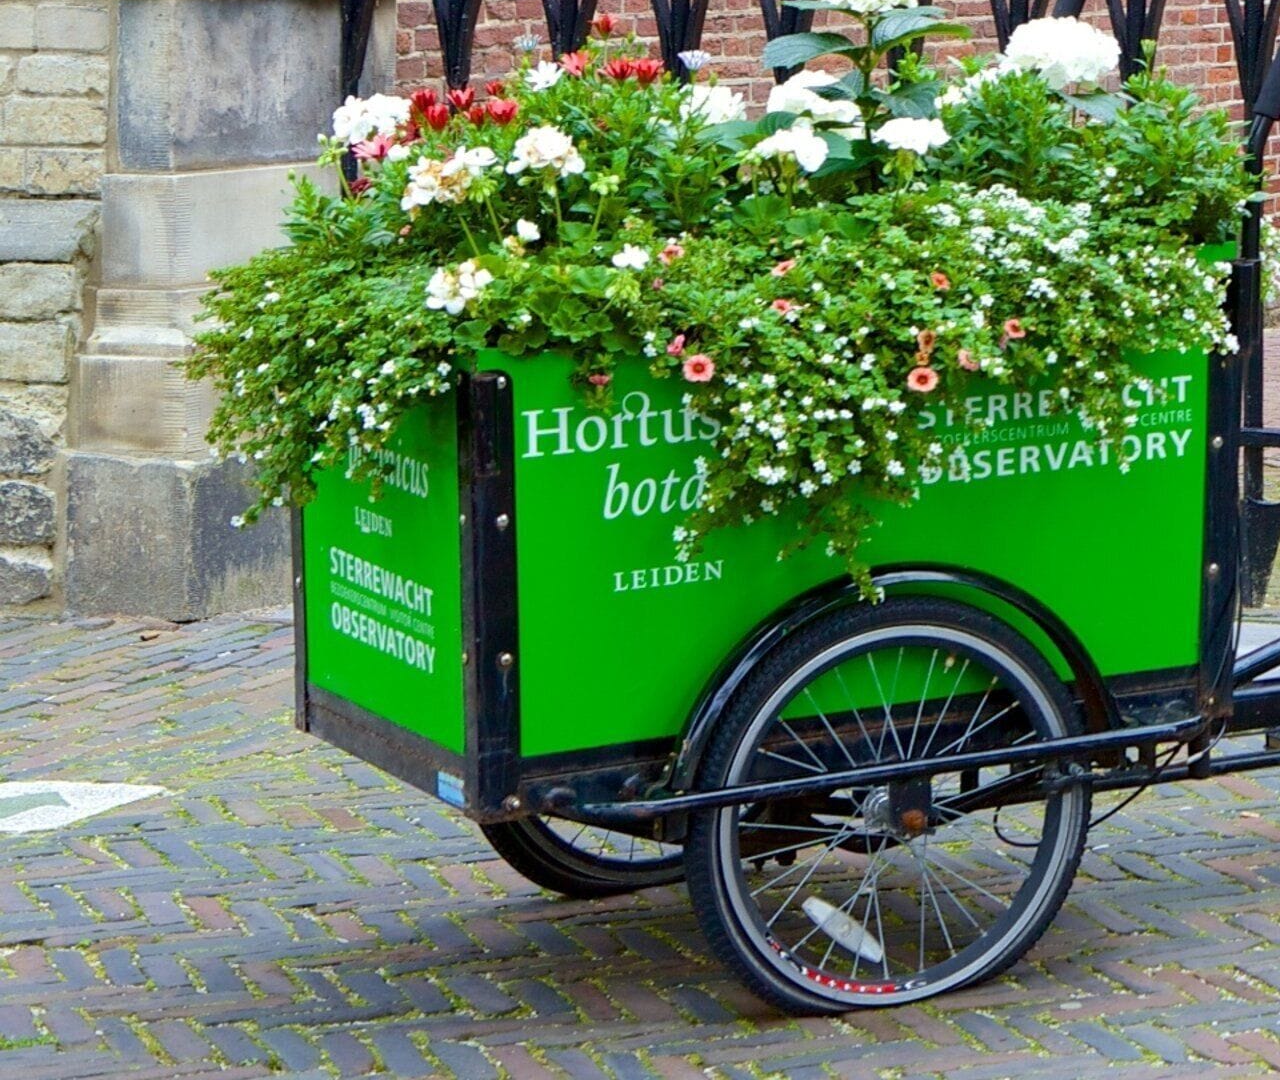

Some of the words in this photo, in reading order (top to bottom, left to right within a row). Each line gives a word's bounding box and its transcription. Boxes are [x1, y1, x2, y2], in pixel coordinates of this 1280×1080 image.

[521, 391, 721, 459] Hortus
[1140, 408, 1193, 427] CENTRE
[330, 546, 434, 617] STERREWACHT
[613, 559, 725, 593] LEIDEN
[331, 601, 436, 674] OBSERVATORY
